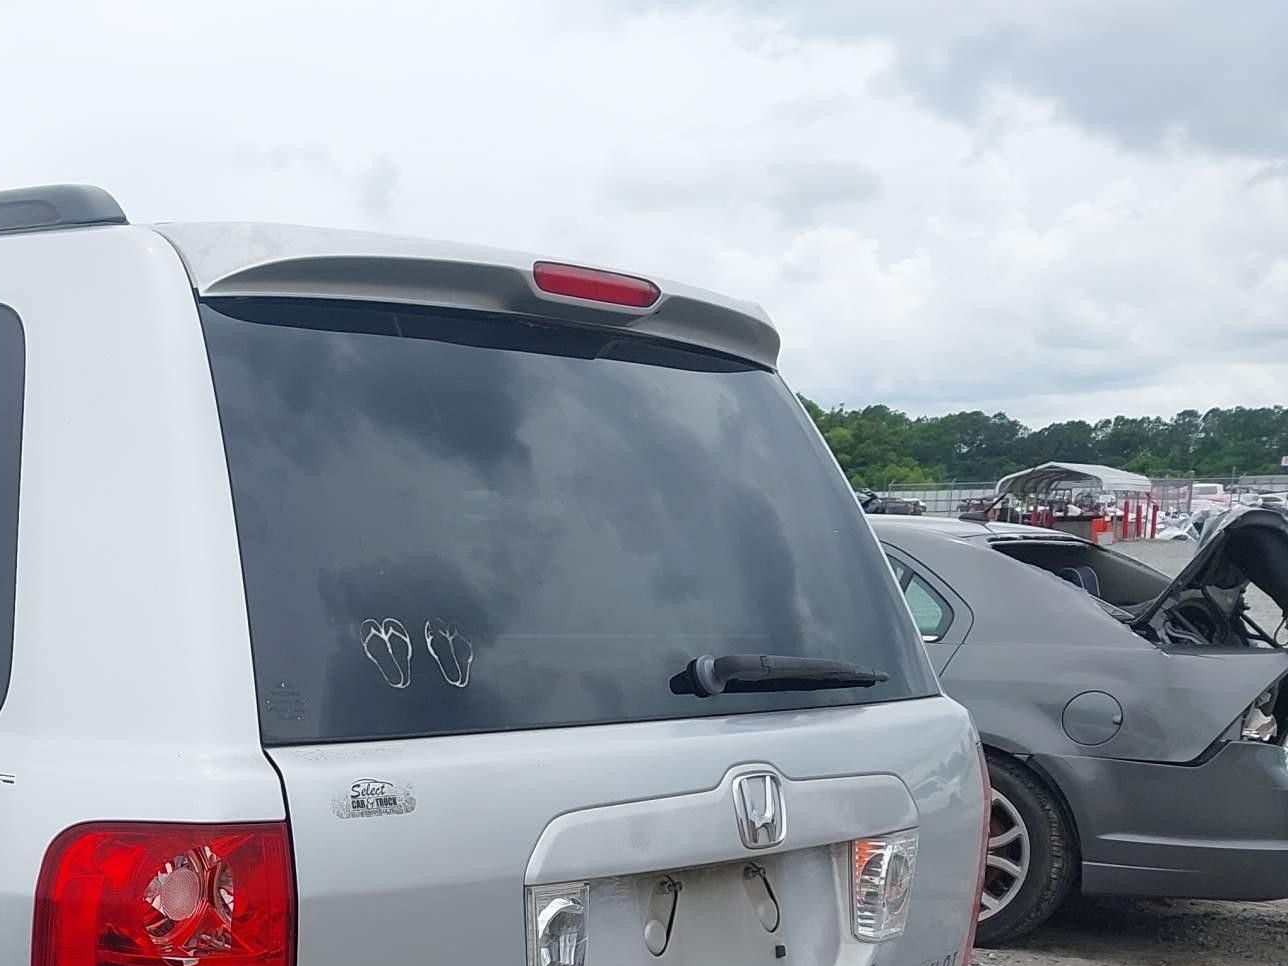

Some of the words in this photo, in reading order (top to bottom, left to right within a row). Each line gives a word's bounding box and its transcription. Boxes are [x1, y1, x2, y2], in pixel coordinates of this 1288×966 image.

[350, 783, 386, 798] Select
[352, 799, 365, 809] CAR
[366, 797, 374, 810] &
[375, 797, 398, 807] TRUCK
